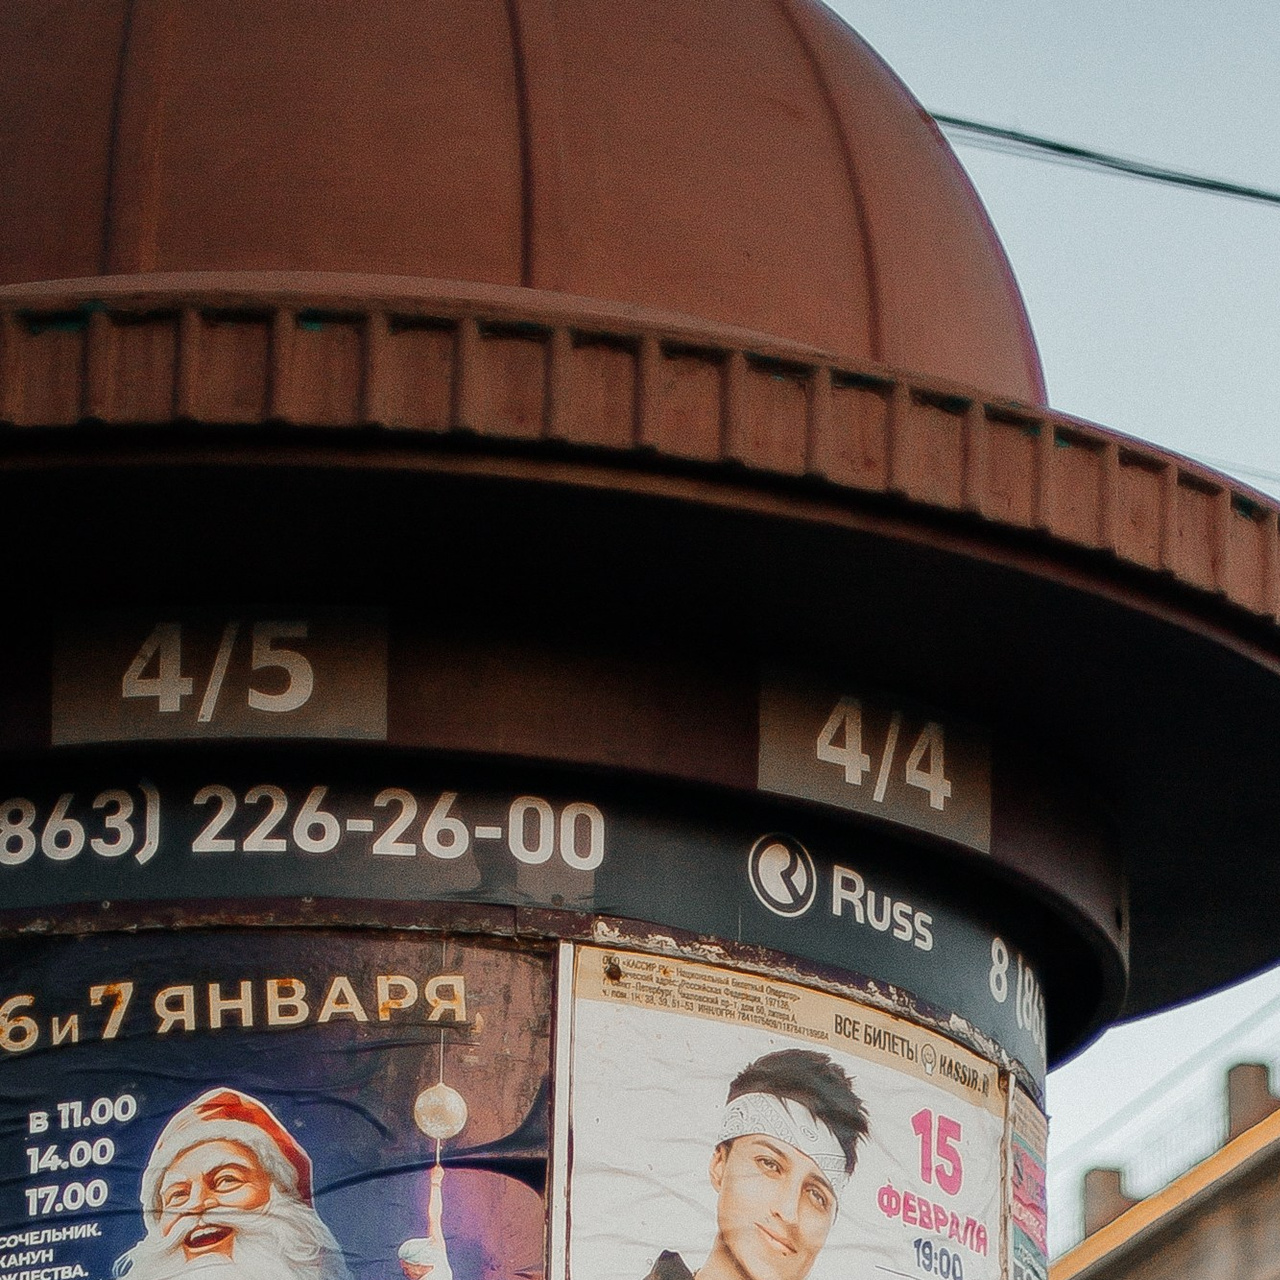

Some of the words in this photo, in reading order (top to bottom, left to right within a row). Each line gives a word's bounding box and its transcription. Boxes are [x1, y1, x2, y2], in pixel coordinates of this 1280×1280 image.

[121, 620, 315, 723] 4/5
[816, 698, 952, 811] 4/4
[0, 783, 160, 866] 863)
[192, 785, 605, 871] 226-26-00
[0, 994, 40, 1053] 6
[51, 1013, 80, 1046] и
[89, 981, 135, 1040] 7
[153, 974, 469, 1034] ЯНВАРЯ
[834, 1013, 861, 1042] ВСЕ
[863, 1022, 918, 1063] БИЛЕТЫ
[57, 1094, 138, 1130] 11.00
[26, 1137, 115, 1175] 14.00
[911, 1107, 963, 1197] 15
[25, 1178, 109, 1216] 17.00
[877, 1182, 989, 1257] ФЕВРАЛЯ
